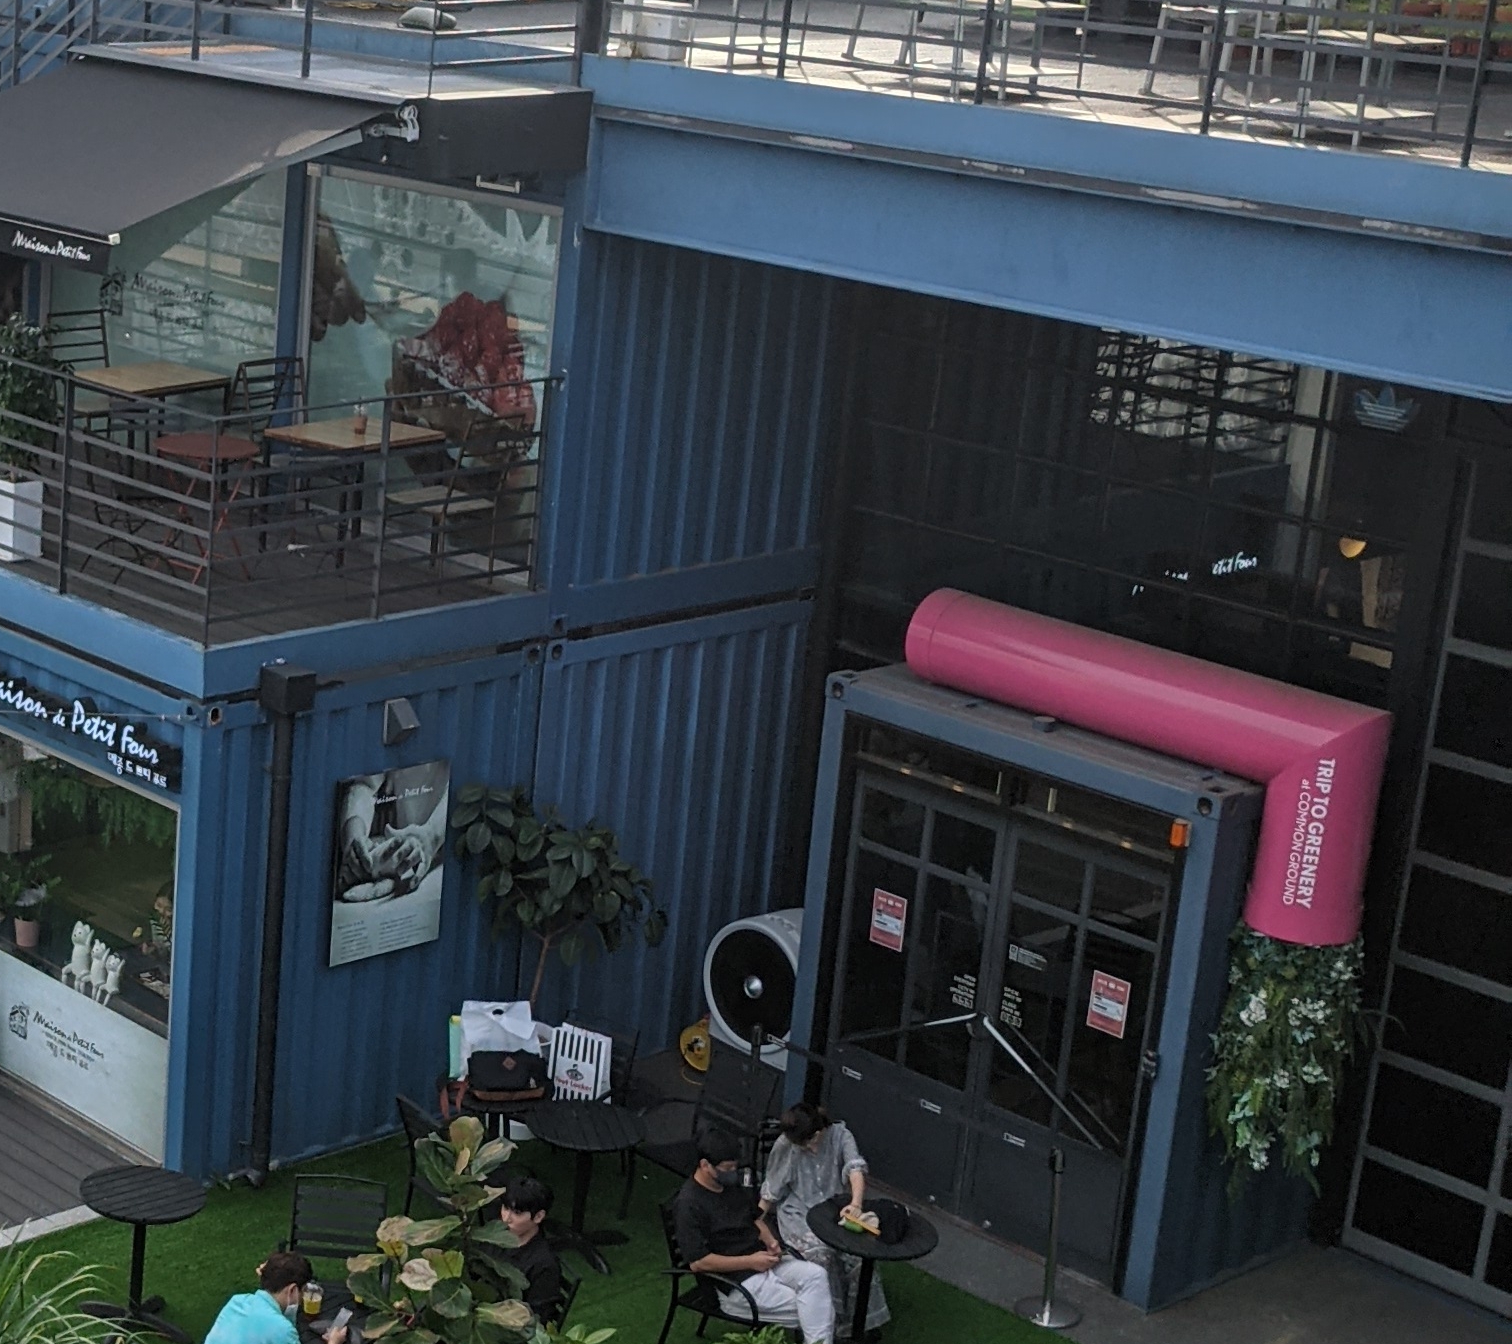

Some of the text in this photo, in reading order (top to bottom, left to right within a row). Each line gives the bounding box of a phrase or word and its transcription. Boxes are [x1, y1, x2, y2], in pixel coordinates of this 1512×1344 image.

[12, 230, 49, 253] Maison
[52, 708, 66, 727] de
[71, 699, 117, 747] Petit
[120, 725, 160, 765] Four
[107, 752, 124, 775] 메종
[125, 763, 134, 774] 드
[1282, 778, 1311, 906] at COMMON GROUND
[1296, 758, 1336, 909] TRIP TO GREENERY
[33, 1010, 67, 1038] Maison
